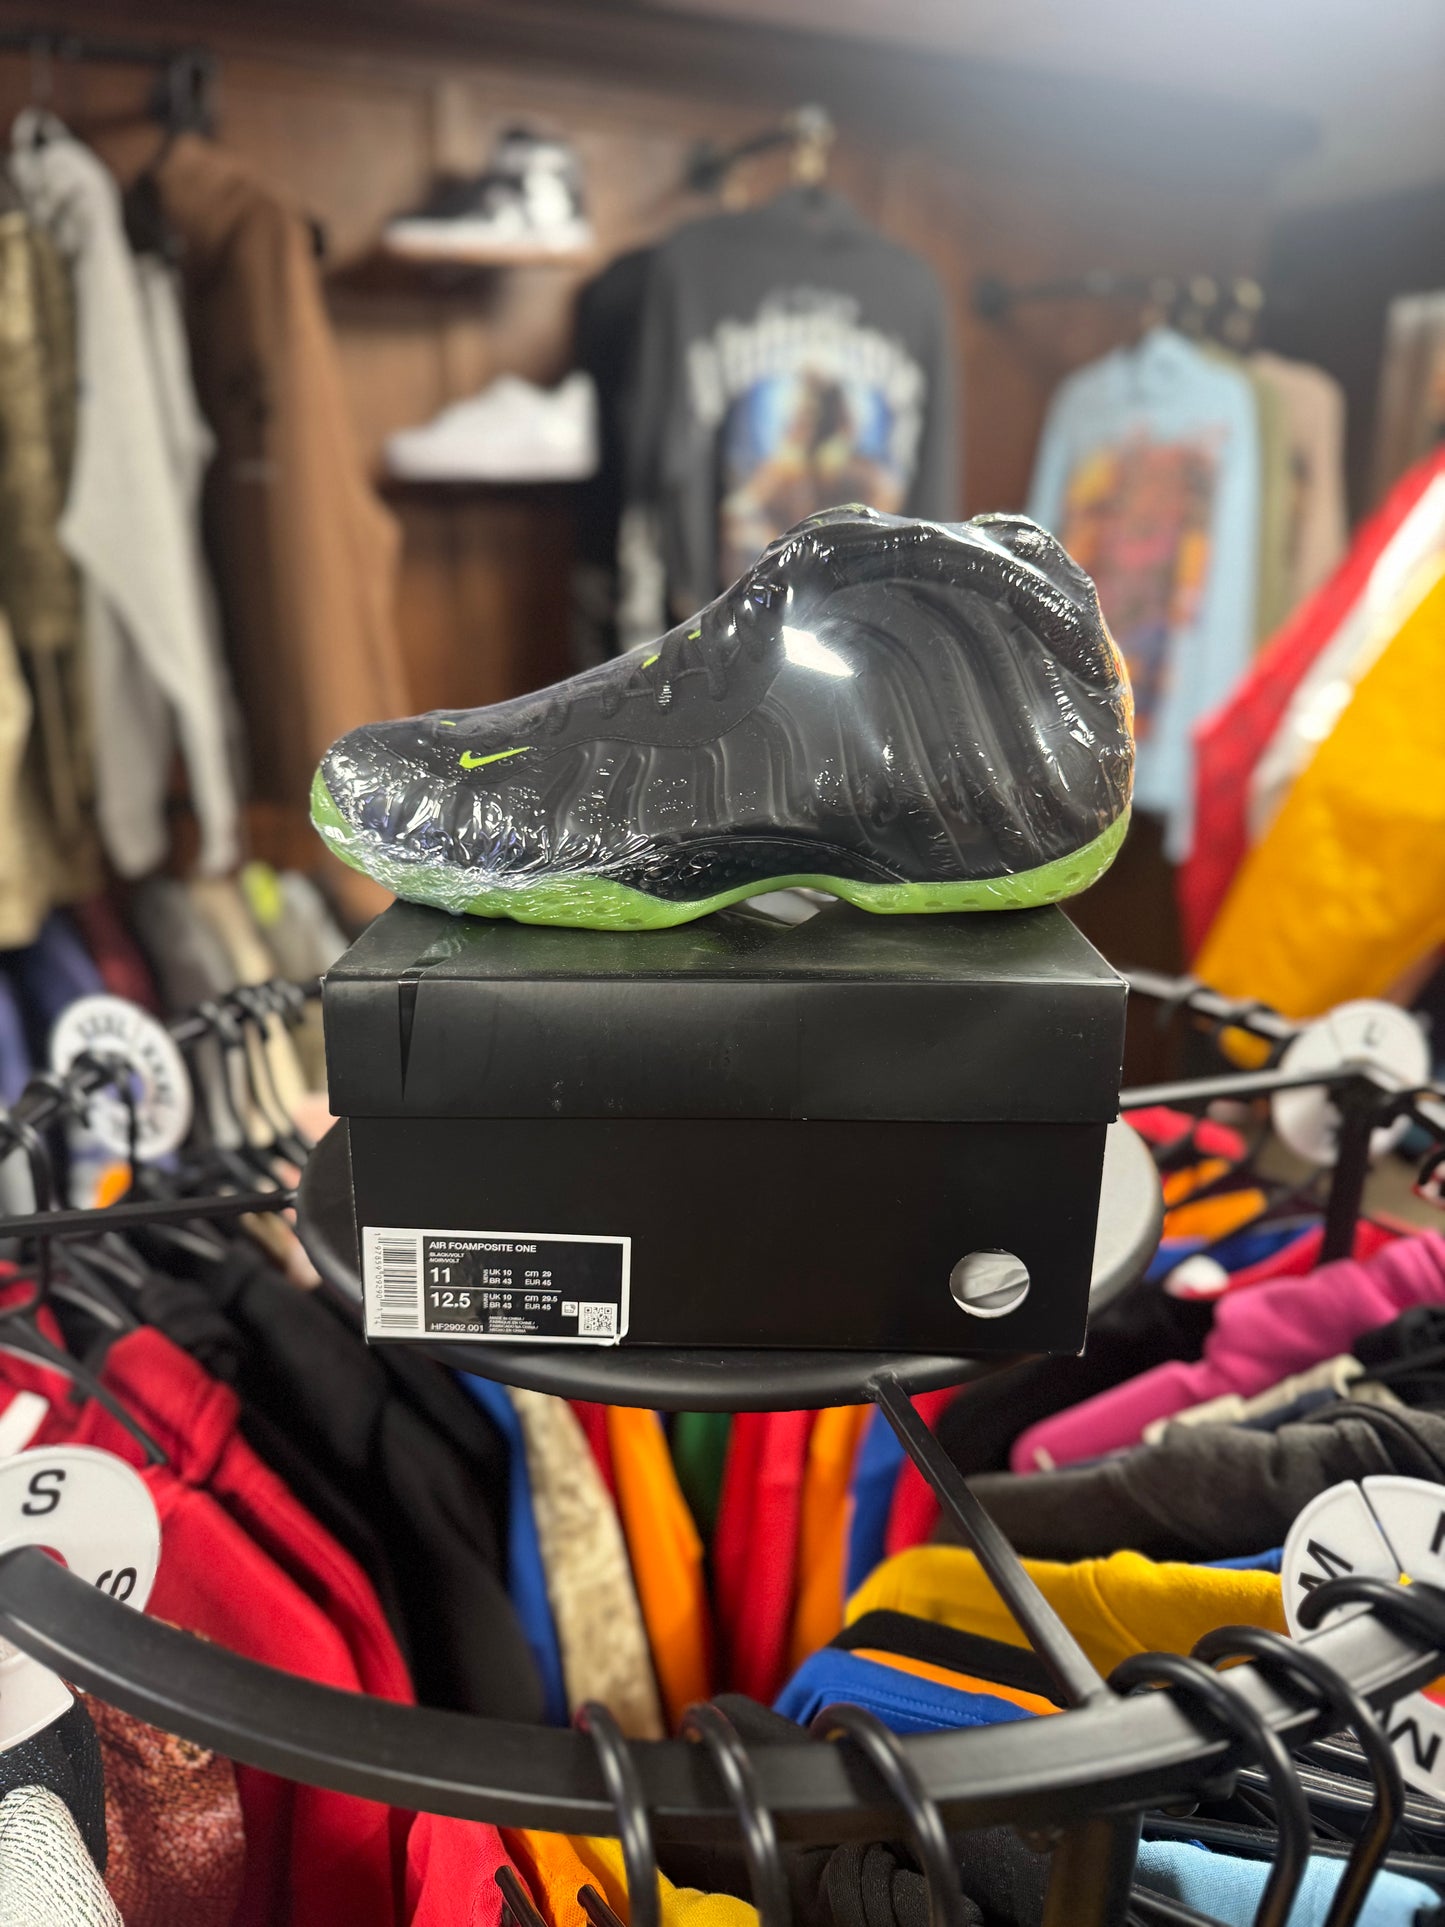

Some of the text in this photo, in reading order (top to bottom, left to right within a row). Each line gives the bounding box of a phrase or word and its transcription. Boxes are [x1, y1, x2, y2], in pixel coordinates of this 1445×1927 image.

[429, 1241, 537, 1253] AIR FOAMPOSITE ONE
[430, 1267, 451, 1283] 11
[430, 1291, 471, 1309] 12.5
[503, 1293, 512, 1301] 10
[541, 1295, 558, 1303] 29.5
[431, 1322, 484, 1332] HF2902 001
[22, 1469, 66, 1516] S
